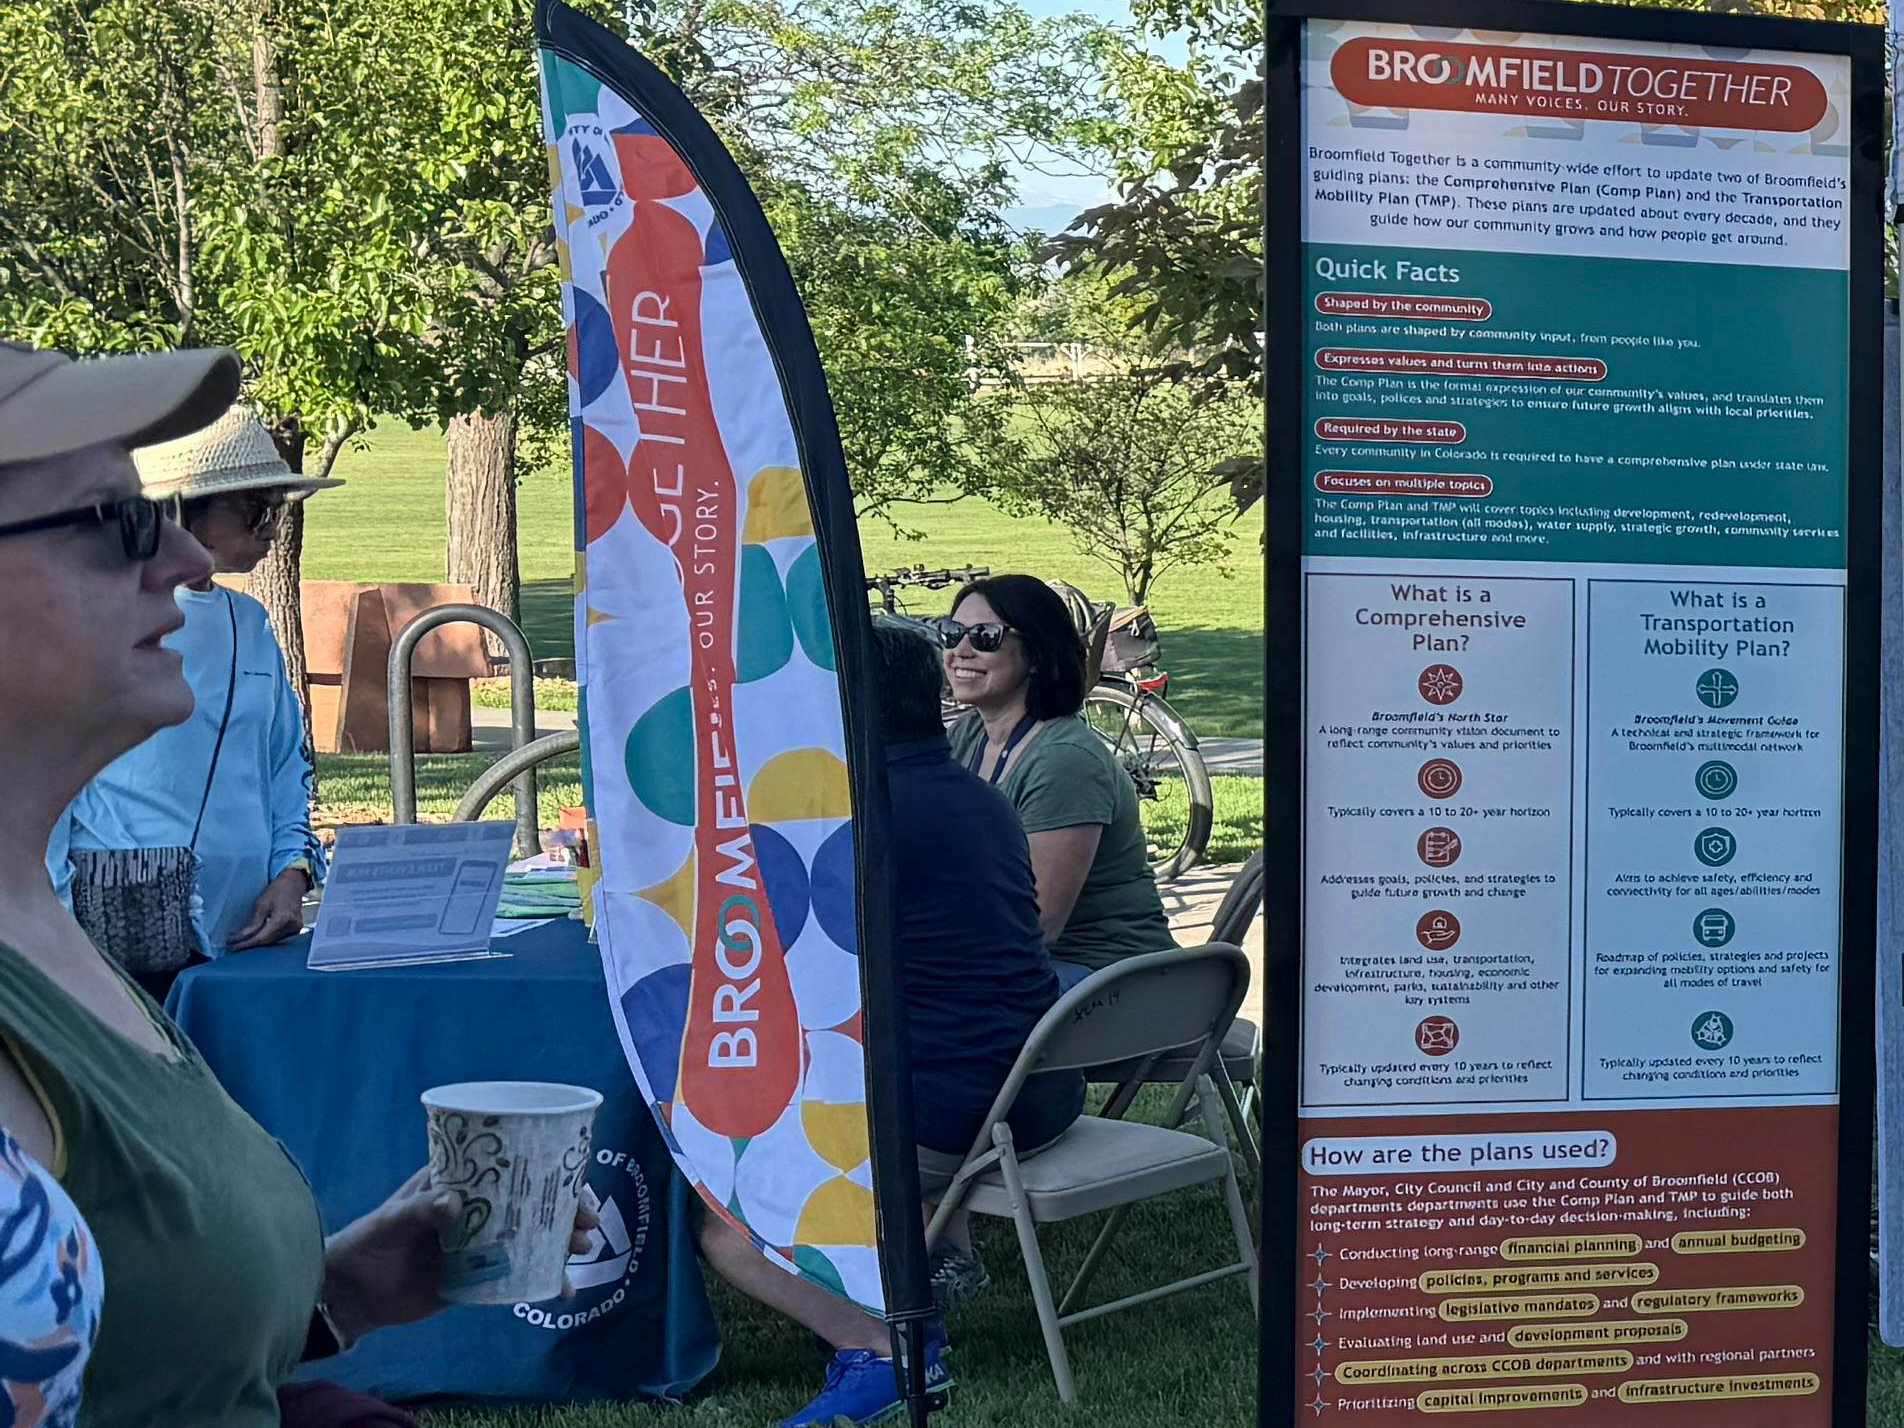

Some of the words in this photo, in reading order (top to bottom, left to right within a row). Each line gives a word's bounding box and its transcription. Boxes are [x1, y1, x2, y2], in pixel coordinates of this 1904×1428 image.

[1475, 93, 1518, 105] MANY
[1526, 95, 1588, 110] VOICES.
[1597, 99, 1629, 112] OUR
[1637, 102, 1688, 116] STORY.
[1315, 257, 1387, 280] Quick
[1396, 260, 1459, 282] Facts
[1324, 297, 1368, 310] Shaped
[1372, 299, 1387, 311] by
[1391, 300, 1411, 311] the
[1415, 303, 1483, 316] community
[693, 480, 719, 575] STORY.
[1390, 583, 1447, 602] What
[1479, 589, 1491, 602] a
[1670, 590, 1724, 607] What
[1755, 596, 1765, 608] a
[694, 588, 715, 649] OUR
[1355, 608, 1526, 630] Comprehensive
[1640, 613, 1793, 635] Transportation
[1413, 633, 1469, 651] Plan?
[1644, 638, 1728, 659] Mobility
[1736, 639, 1790, 656] Plan?
[596, 1149, 627, 1167] OF
[1310, 1146, 1363, 1166] How
[1372, 1148, 1412, 1163] are
[1421, 1143, 1461, 1162] the
[1470, 1141, 1533, 1166] plans
[1542, 1138, 1608, 1159] used?
[513, 1288, 625, 1330] COLORADO
